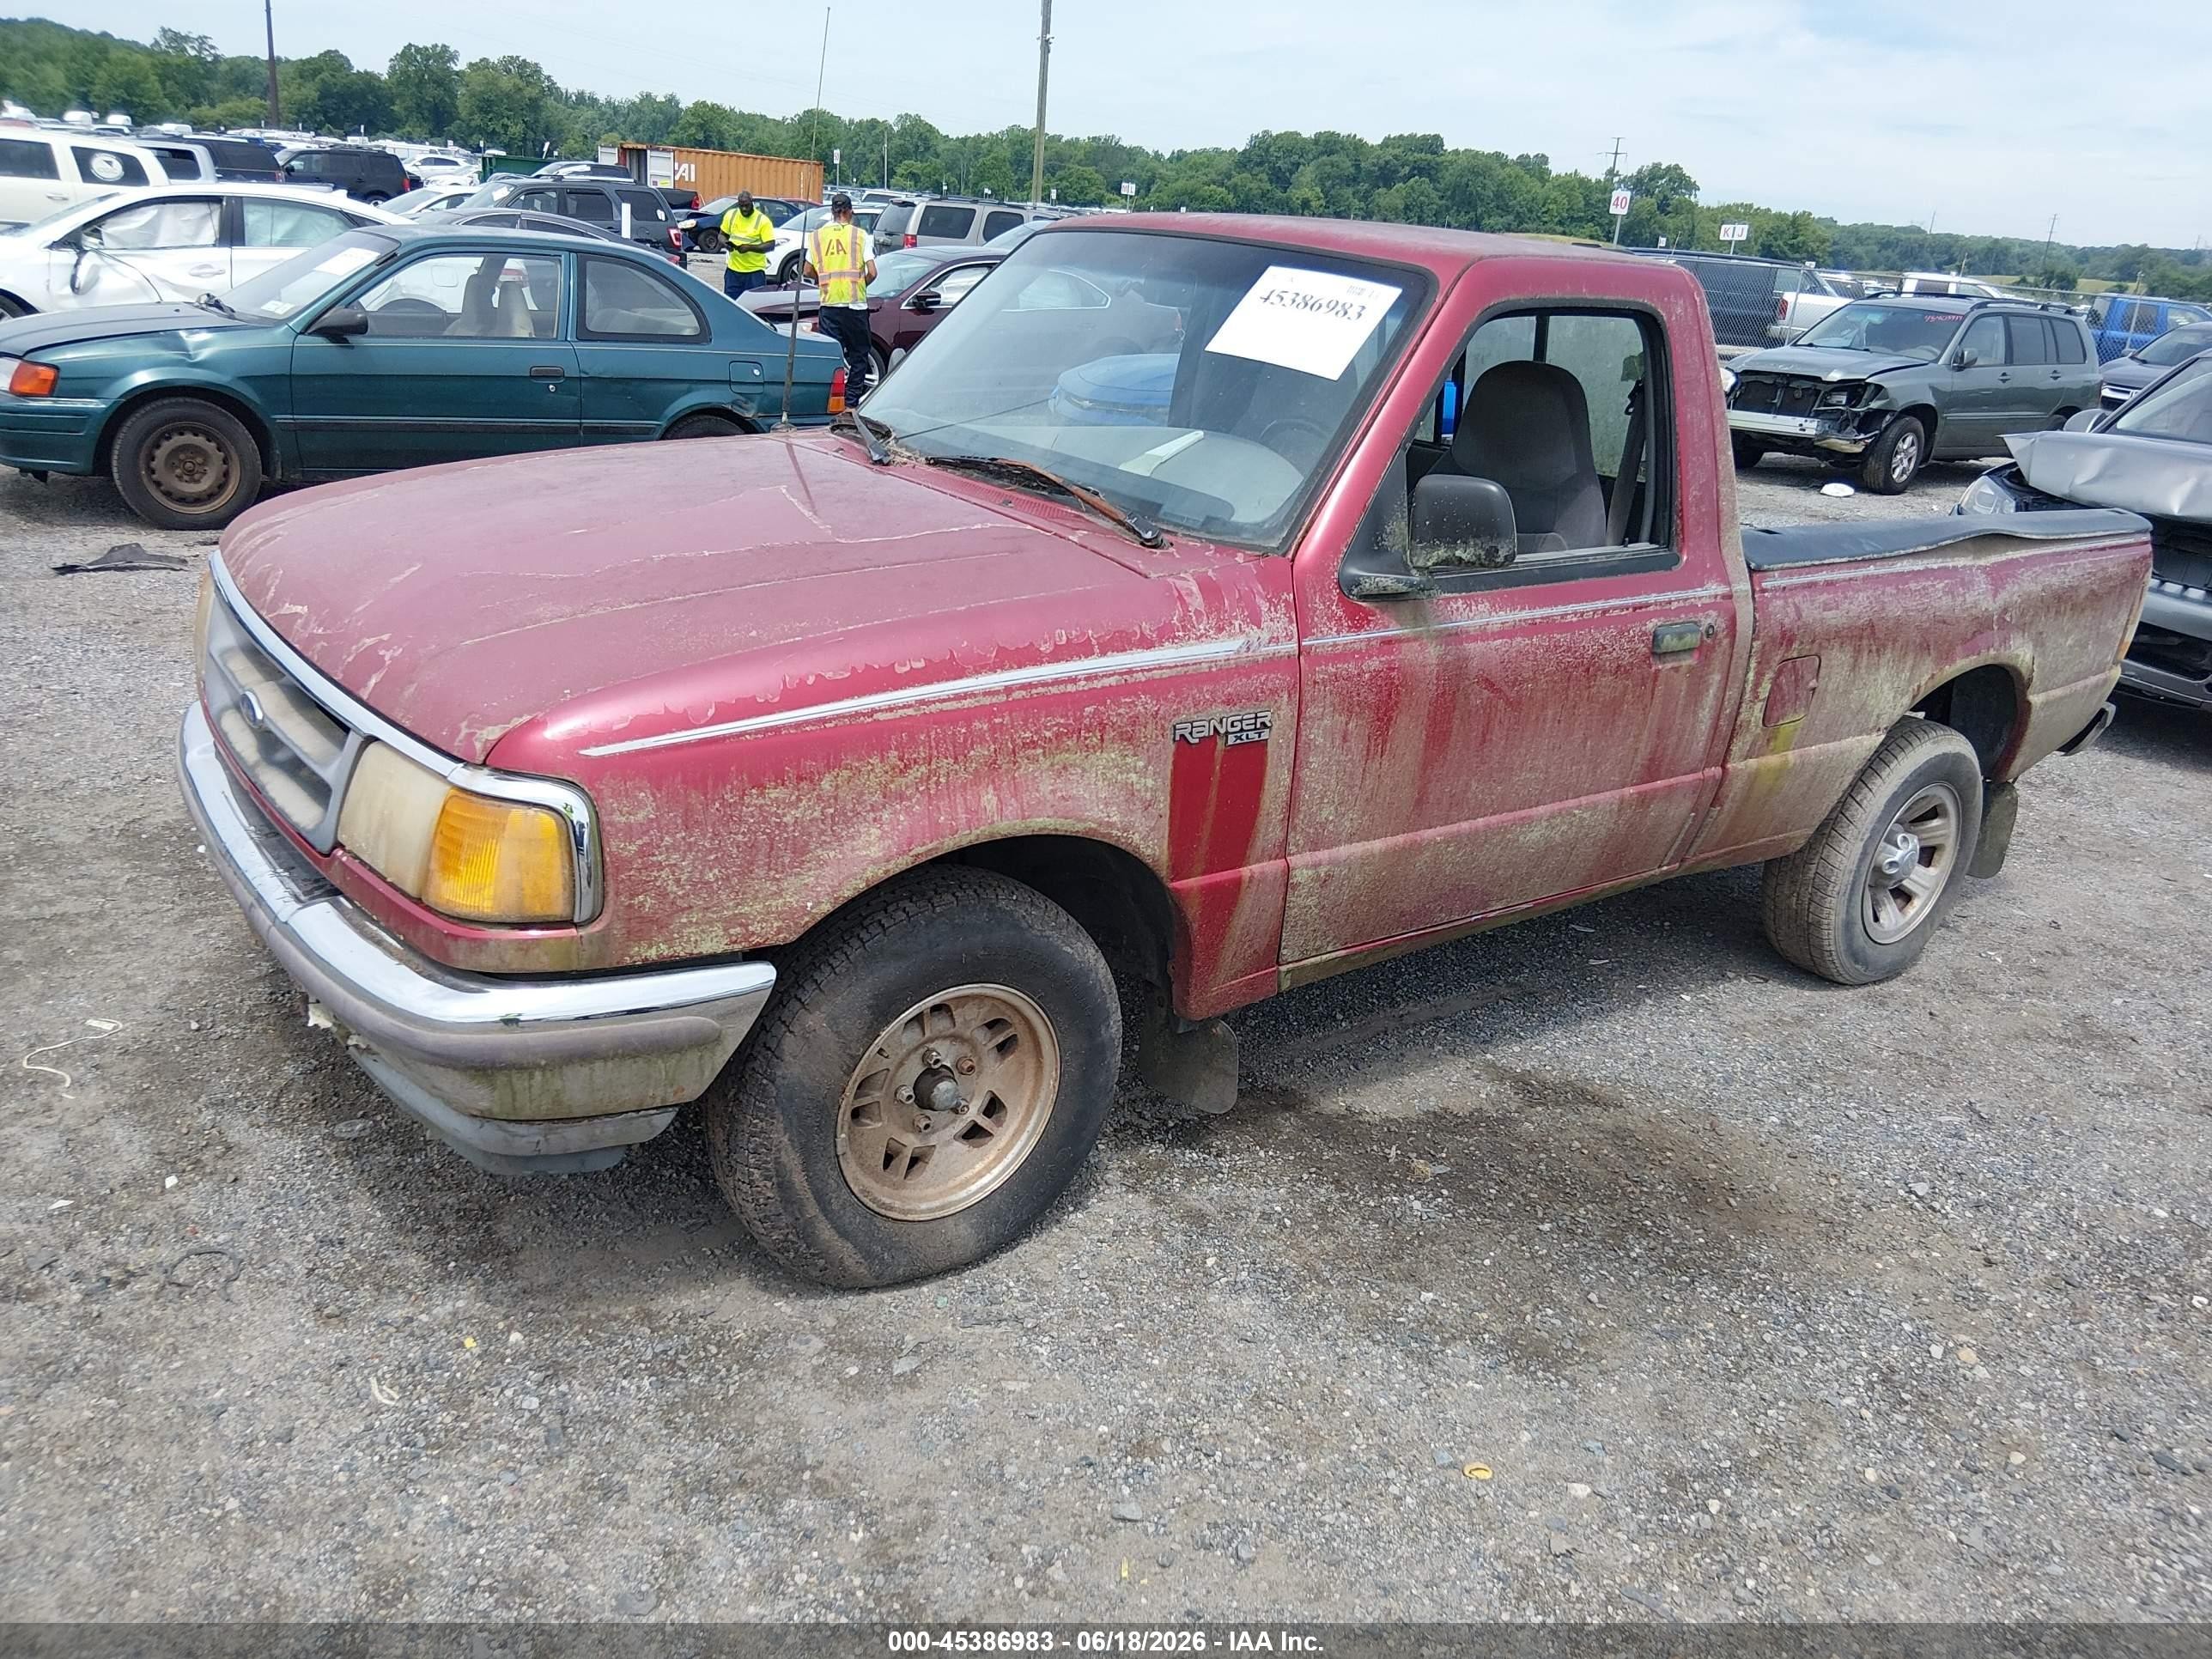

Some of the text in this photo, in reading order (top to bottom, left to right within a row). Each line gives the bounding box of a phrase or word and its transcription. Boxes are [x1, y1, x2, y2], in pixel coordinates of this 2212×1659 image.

[1613, 196, 1628, 210] 40
[1723, 227, 1745, 238] K J
[1259, 289, 1367, 321] 45386983
[1174, 711, 1272, 744] RANGER
[1233, 730, 1267, 743] XLT
